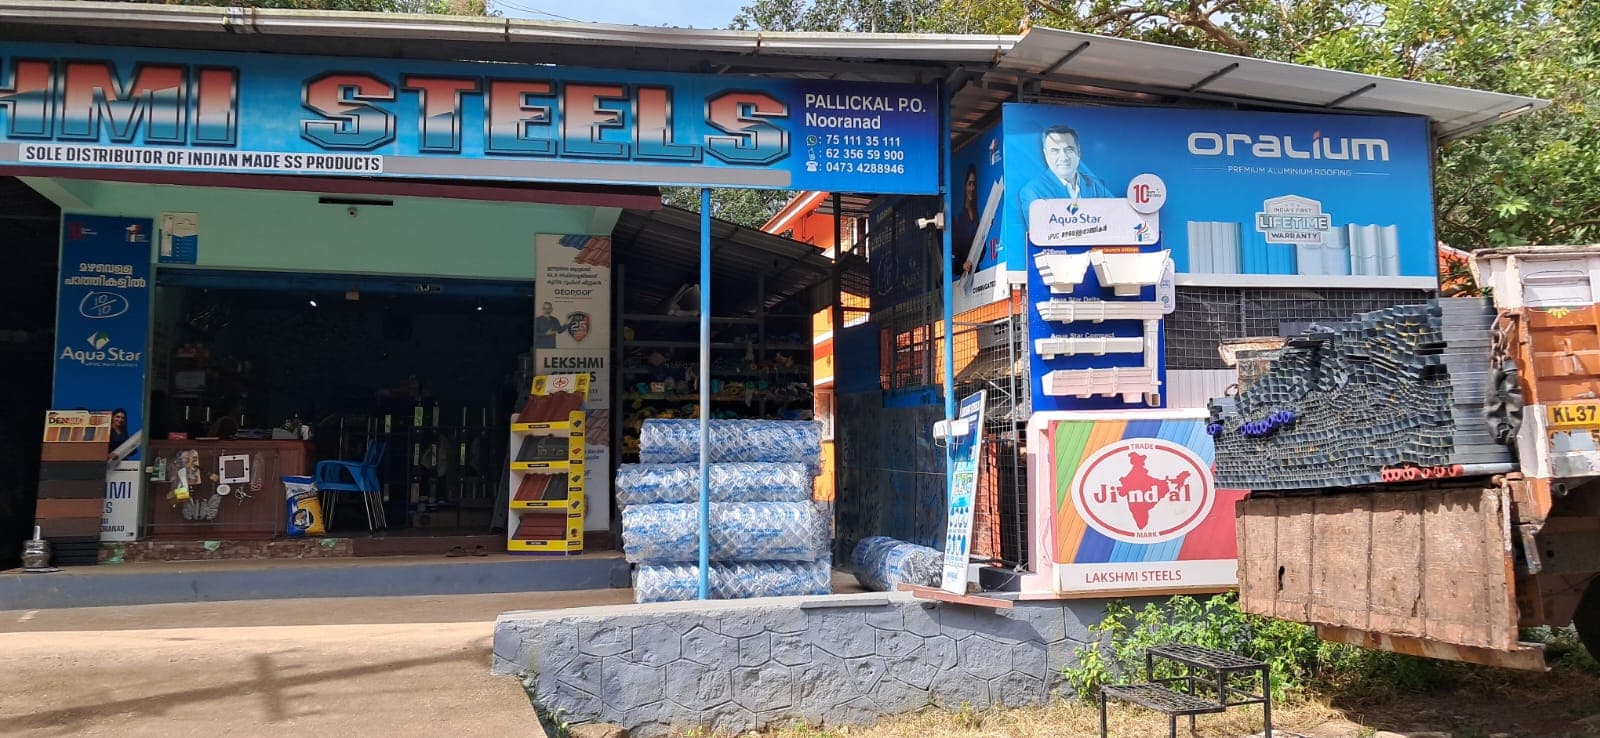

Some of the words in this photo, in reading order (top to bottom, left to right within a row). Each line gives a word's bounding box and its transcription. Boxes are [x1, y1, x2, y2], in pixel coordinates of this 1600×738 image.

[805, 93, 894, 111] PALLICKAL
[898, 97, 927, 113] P.O.
[301, 69, 792, 166] STEELS
[805, 112, 881, 129] Nooranad
[826, 134, 840, 145] 75
[843, 135, 861, 147] 111
[865, 136, 880, 147] 35
[882, 137, 901, 148] 111
[26, 145, 63, 161] SOLE
[66, 147, 163, 164] DISTRIBUTOR
[166, 150, 185, 166] OF
[187, 151, 238, 167] INDIAN
[242, 153, 281, 168] MADE
[284, 155, 303, 169] SS
[306, 156, 380, 171] PRODUCTS
[826, 148, 840, 159] 62
[843, 149, 864, 160] 356
[867, 149, 881, 160] 59
[883, 150, 904, 161] 900
[826, 162, 854, 173] 0473
[856, 163, 905, 174] 4288946
[1227, 165, 1266, 174] PREMIUM
[1267, 167, 1314, 176] ALUMINIUM
[1314, 168, 1353, 177] ROOFING
[1048, 213, 1078, 227] Aqua
[1079, 213, 1102, 224] Star
[1258, 214, 1329, 231] LIFETIME
[1271, 232, 1319, 240] WARRANTY
[60, 345, 106, 364] Aqua
[107, 347, 143, 361] Star
[543, 356, 605, 370] LEKSHMI
[1553, 405, 1597, 422] KL37
[1093, 483, 1192, 504] Jindal
[1085, 572, 1139, 584] LAKSHMI
[1141, 570, 1182, 582] STEELS
